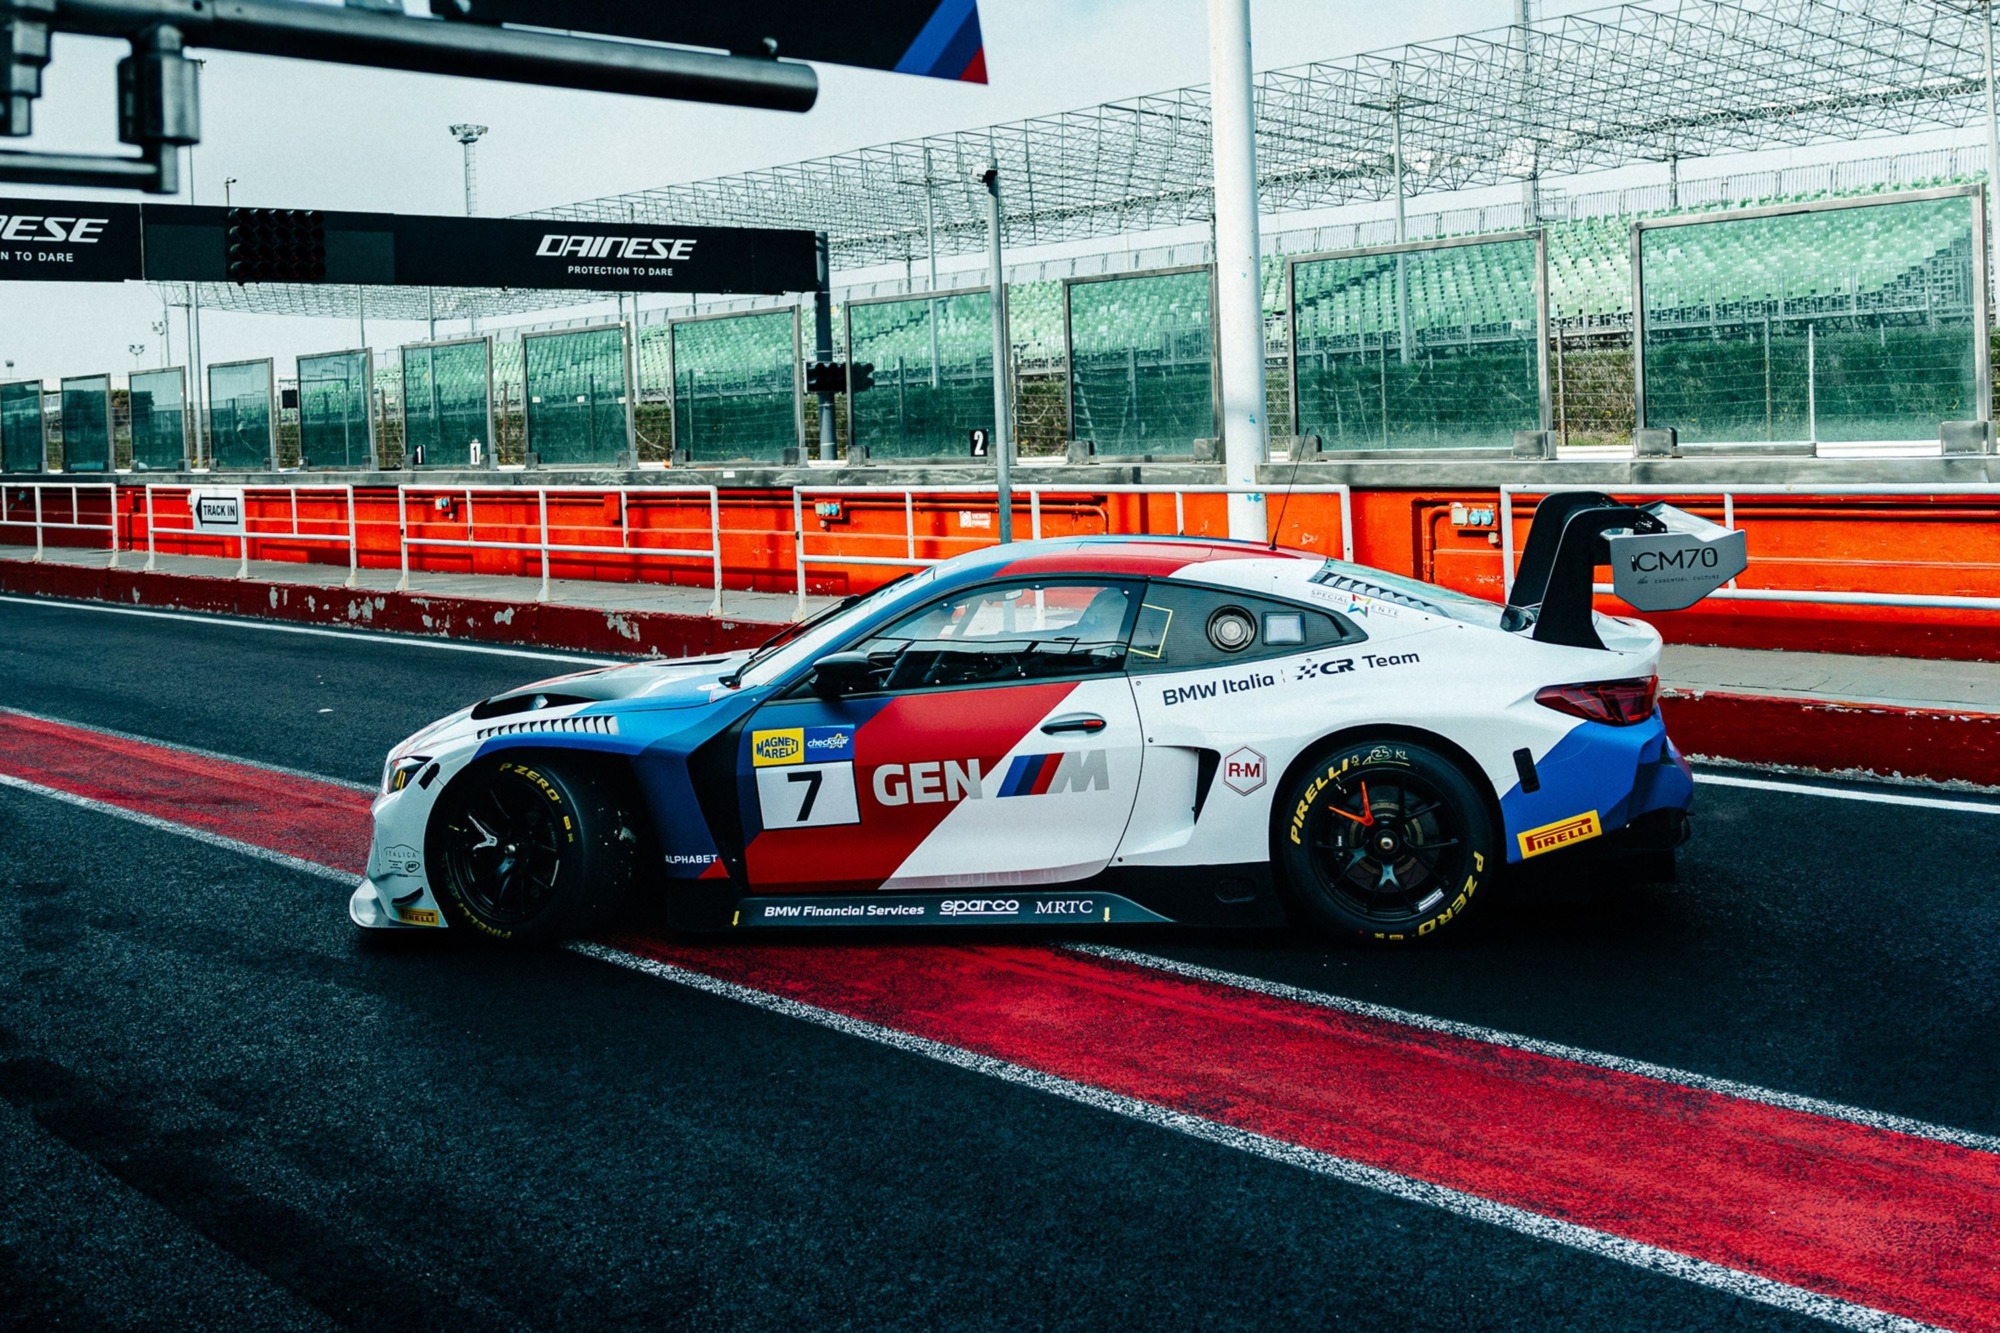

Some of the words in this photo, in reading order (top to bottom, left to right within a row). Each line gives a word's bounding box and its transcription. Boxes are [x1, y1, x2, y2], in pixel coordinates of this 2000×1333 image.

[0, 215, 109, 243] ESE
[15, 251, 32, 261] TO
[38, 252, 74, 262] DARE
[536, 234, 697, 260] DAINESE
[568, 265, 629, 275] PROTECTION
[633, 267, 645, 275] TO
[648, 267, 673, 276] DARE
[973, 430, 985, 456] 2
[416, 445, 422, 464] 1
[473, 445, 478, 463] 1
[203, 504, 226, 516] TRACK
[227, 505, 236, 517] IN
[1162, 681, 1217, 706] BMW
[1222, 673, 1275, 694] Italia
[1361, 653, 1420, 669] Team
[1228, 762, 1260, 778] R-M
[514, 765, 560, 801] ZERO
[872, 758, 983, 806] GEN
[787, 770, 823, 822] 7
[1290, 758, 1349, 845] PIRELLI
[1525, 817, 1593, 852] PIRELLI
[386, 850, 417, 859] ITALICA
[665, 854, 717, 864] ALPHABET
[1473, 851, 1484, 873] P
[764, 906, 802, 917] BMW
[803, 904, 864, 916] Financial
[866, 904, 925, 916] Services
[940, 899, 1019, 917] sparco
[1034, 900, 1093, 914] MRTC
[1418, 875, 1478, 936] ZERO
